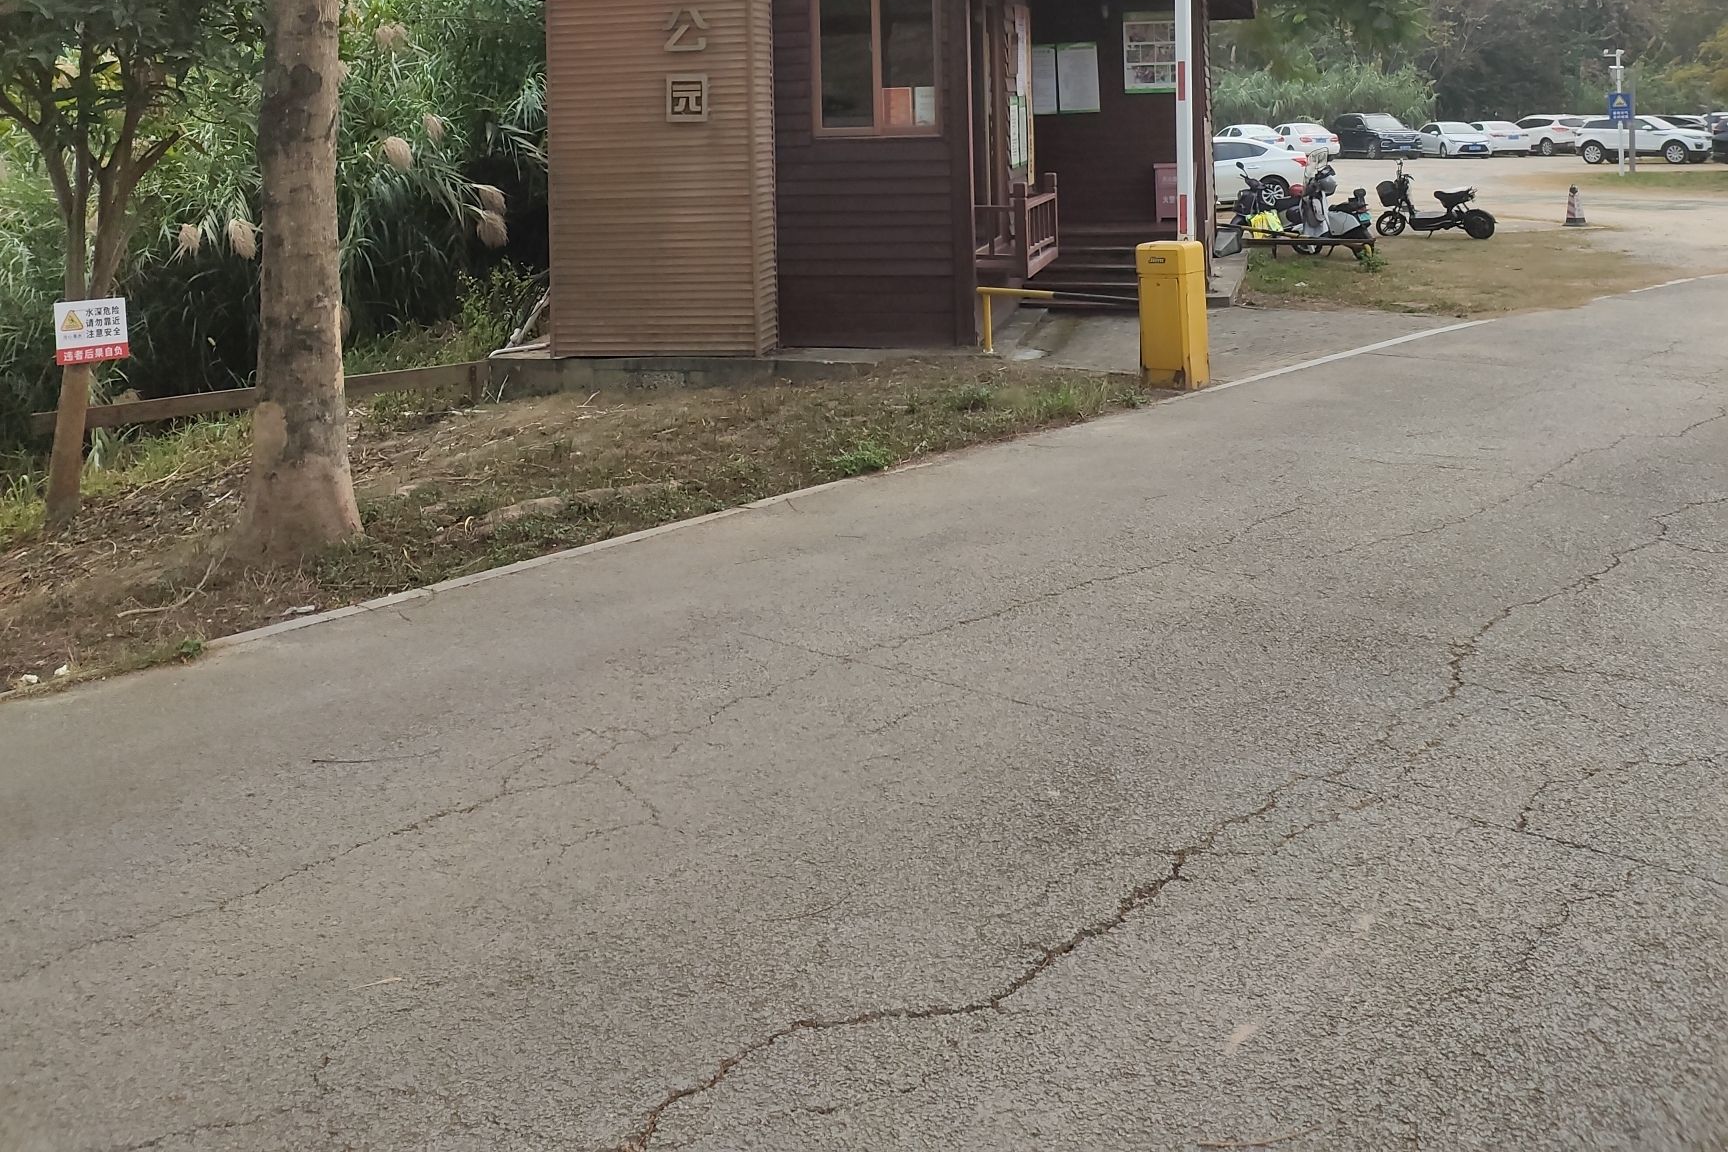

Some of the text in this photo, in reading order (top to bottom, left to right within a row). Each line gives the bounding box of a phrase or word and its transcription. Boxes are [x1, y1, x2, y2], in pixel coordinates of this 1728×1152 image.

[85, 305, 120, 317] 水深危险
[85, 316, 121, 327] 请勿靠近
[86, 327, 121, 339] 注意安全
[63, 345, 123, 362] 违者后果自负
